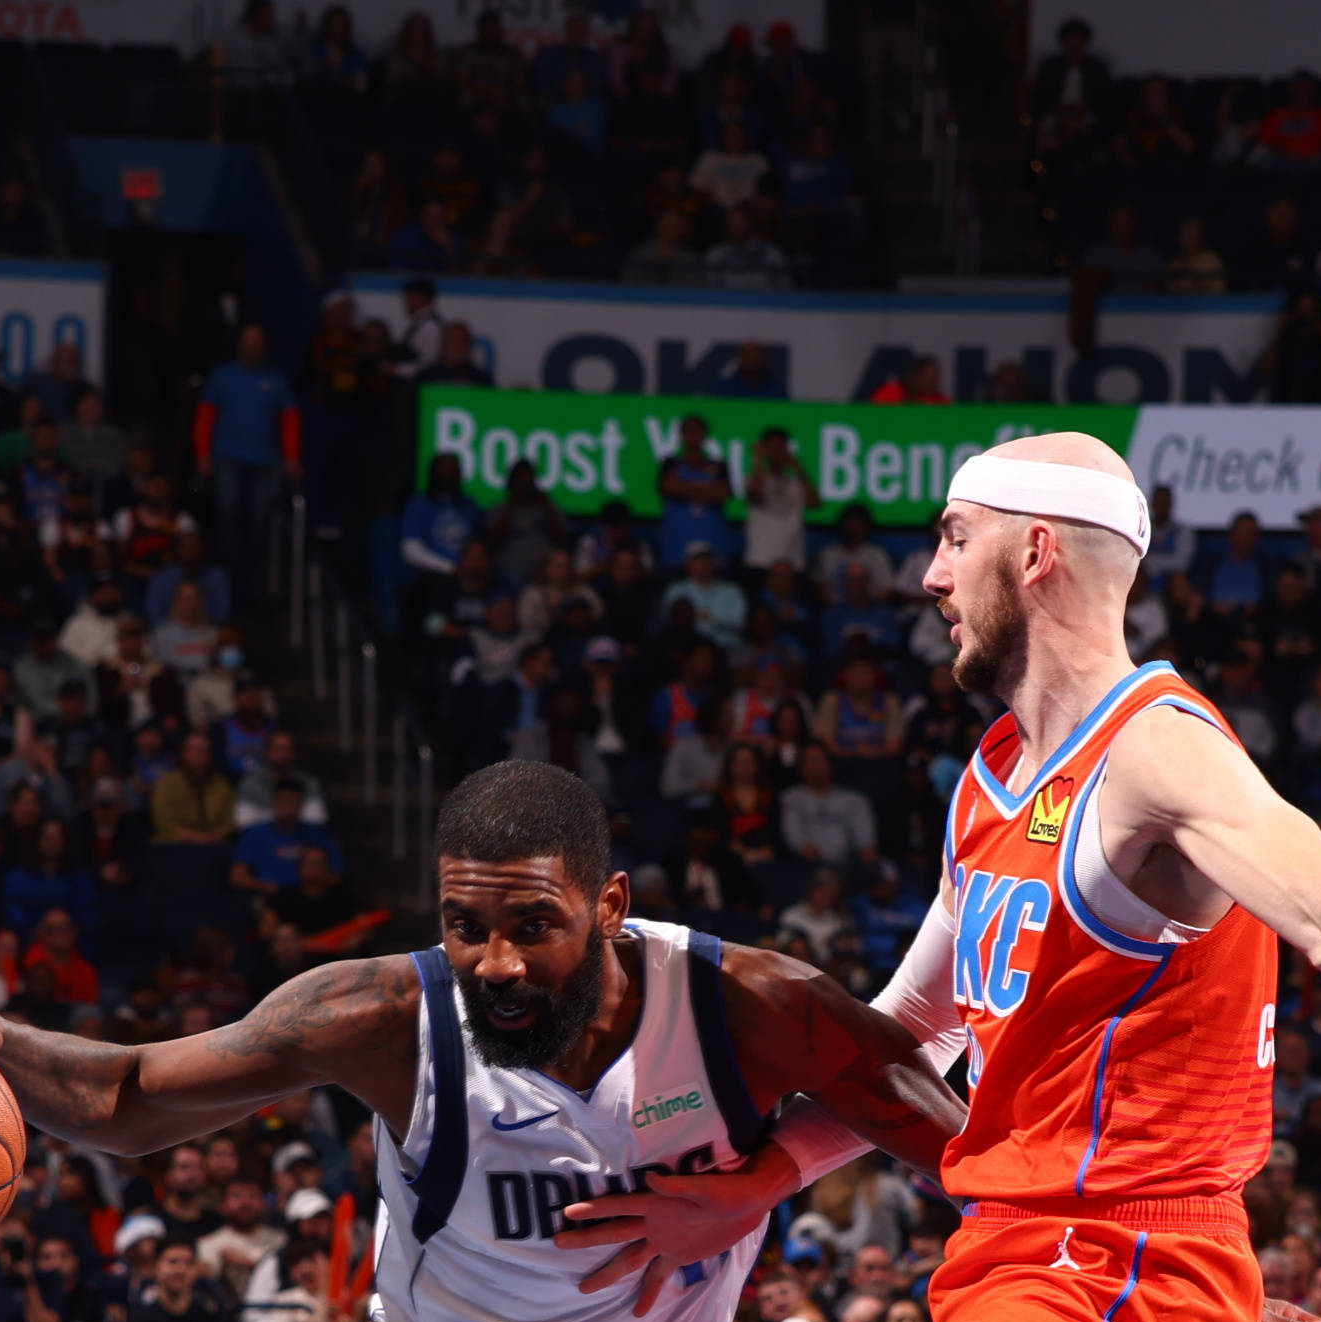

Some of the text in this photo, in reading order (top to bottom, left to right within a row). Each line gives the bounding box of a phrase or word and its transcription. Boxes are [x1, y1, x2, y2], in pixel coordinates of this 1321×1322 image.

[433, 405, 627, 495] Boost
[1150, 433, 1302, 494] Check
[954, 862, 1052, 1018] KC
[632, 1089, 704, 1129] chime
